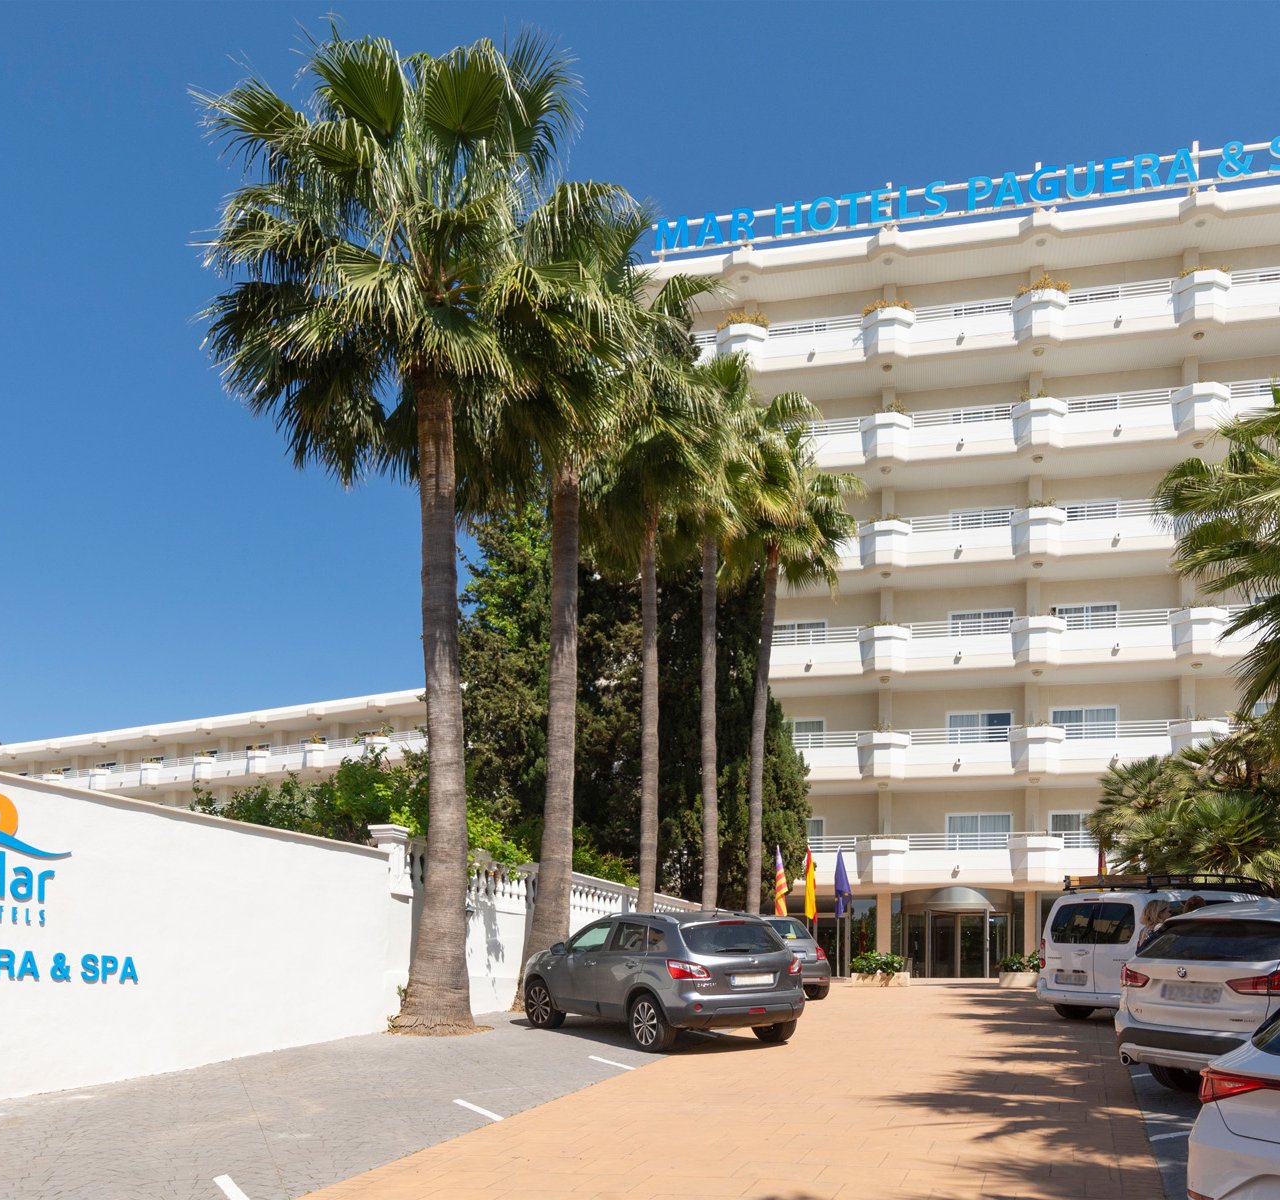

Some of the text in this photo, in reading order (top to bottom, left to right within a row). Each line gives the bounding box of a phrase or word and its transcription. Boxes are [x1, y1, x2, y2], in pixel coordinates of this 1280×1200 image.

[655, 207, 755, 251] MAR
[774, 180, 948, 237] HOTELS
[967, 147, 1199, 211] PAGUERA
[1217, 140, 1254, 180] &
[50, 952, 71, 983] &
[81, 953, 139, 985] SPA
